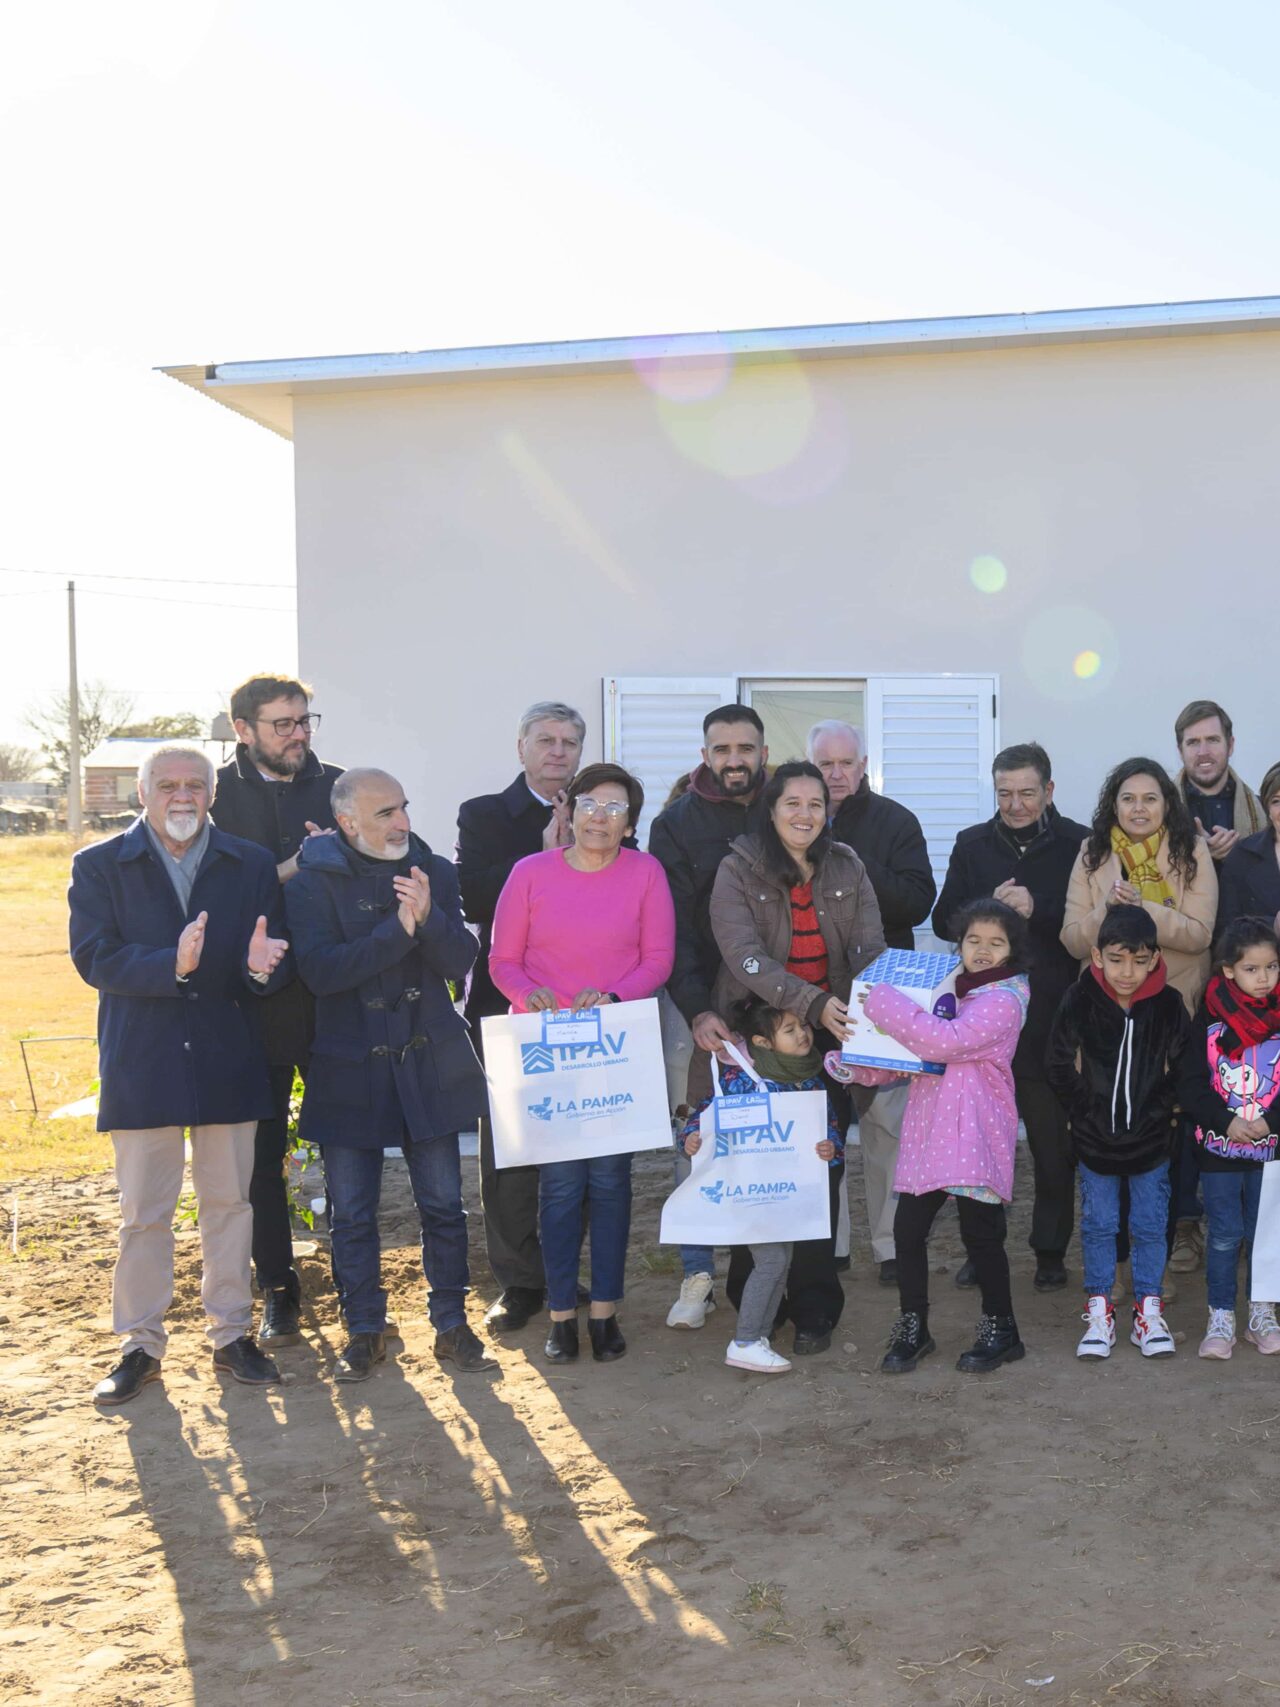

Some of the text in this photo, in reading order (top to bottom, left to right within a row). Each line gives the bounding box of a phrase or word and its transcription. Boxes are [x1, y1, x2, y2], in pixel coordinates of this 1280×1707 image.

[560, 1031, 626, 1061] IPAV
[562, 1057, 629, 1071] DESARROLLO URBANO
[556, 1093, 633, 1113] LA PAMPA
[732, 1120, 795, 1145] IPAV
[769, 1145, 795, 1153] URBANO
[725, 1182, 797, 1197] LA PAMPA
